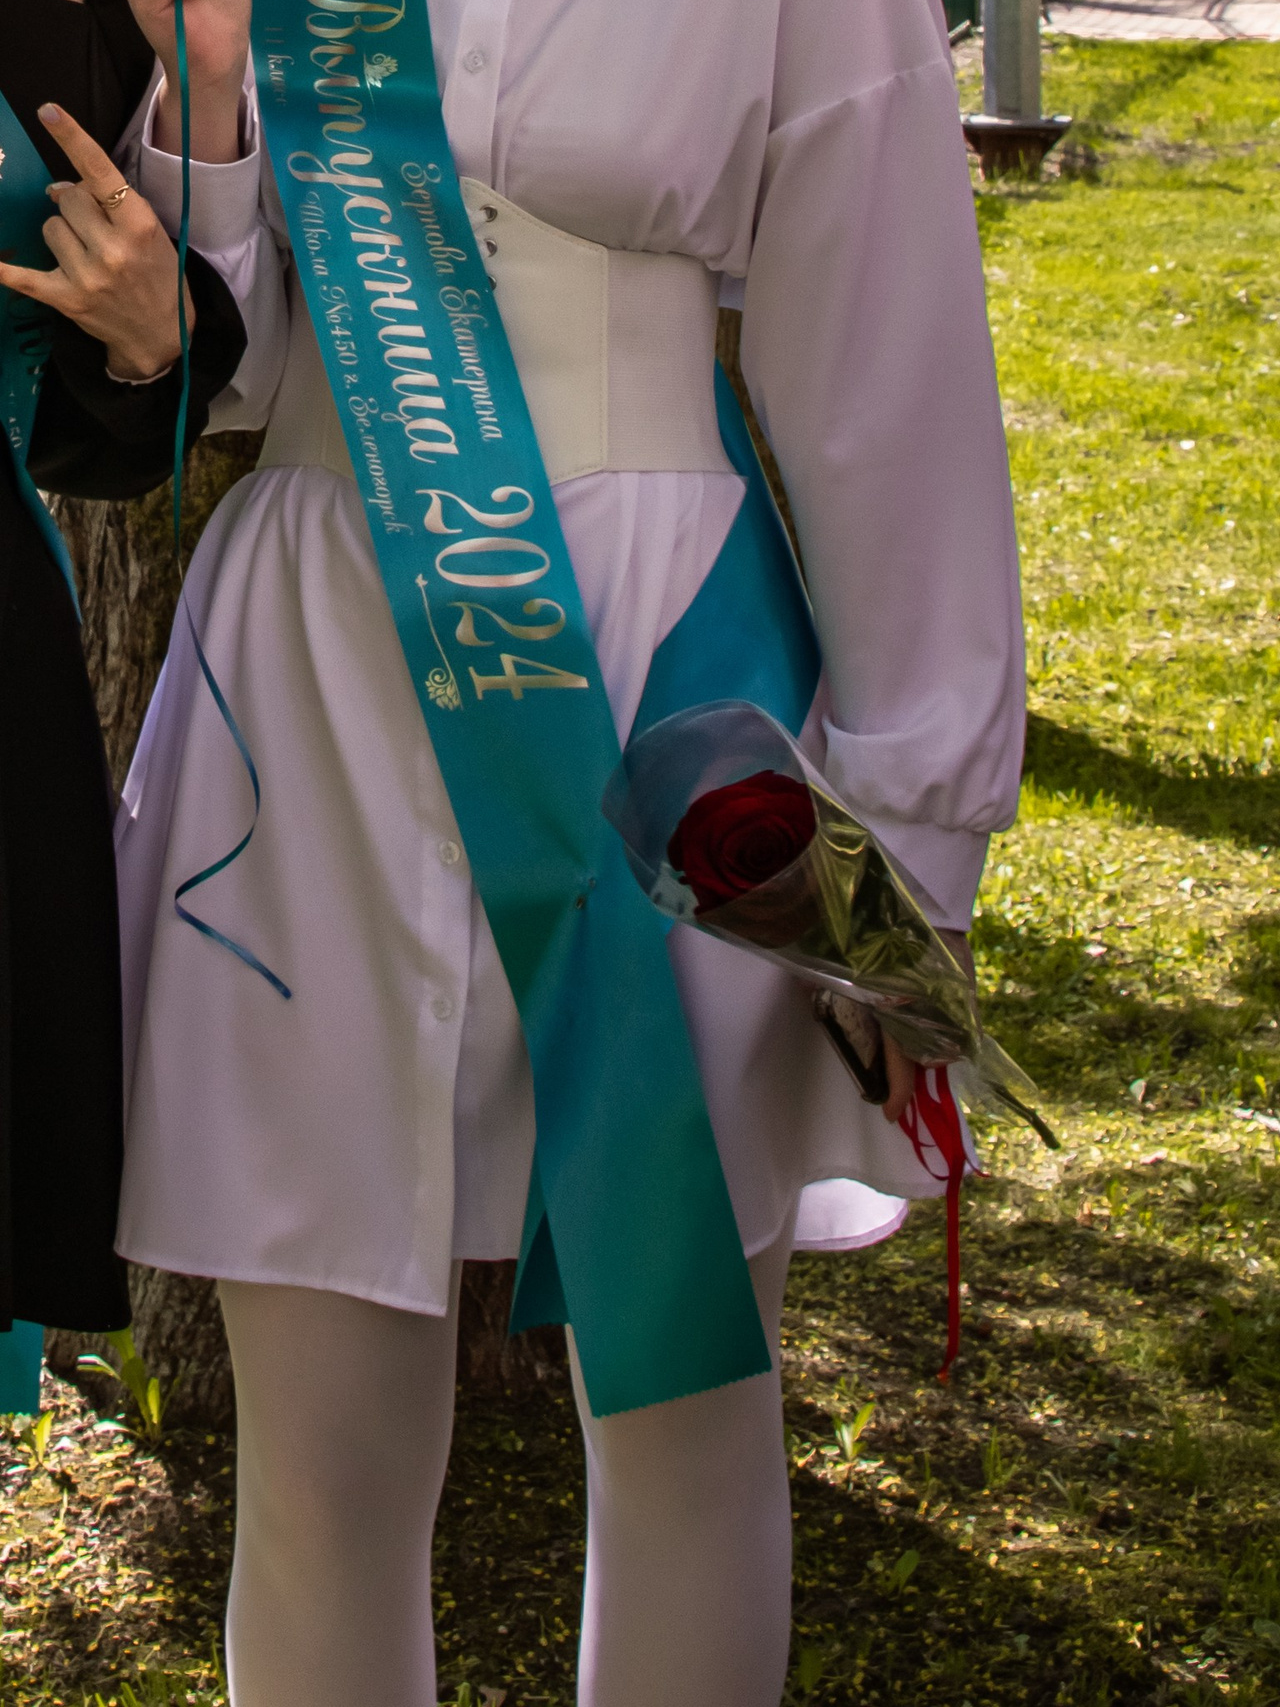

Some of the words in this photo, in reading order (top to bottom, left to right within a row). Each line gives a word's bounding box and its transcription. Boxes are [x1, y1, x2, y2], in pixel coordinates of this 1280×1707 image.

[298, 190, 332, 278] Школа
[347, 395, 414, 536] Зеленогорск
[438, 284, 503, 442] Екатерина
[415, 485, 590, 701] 2024
